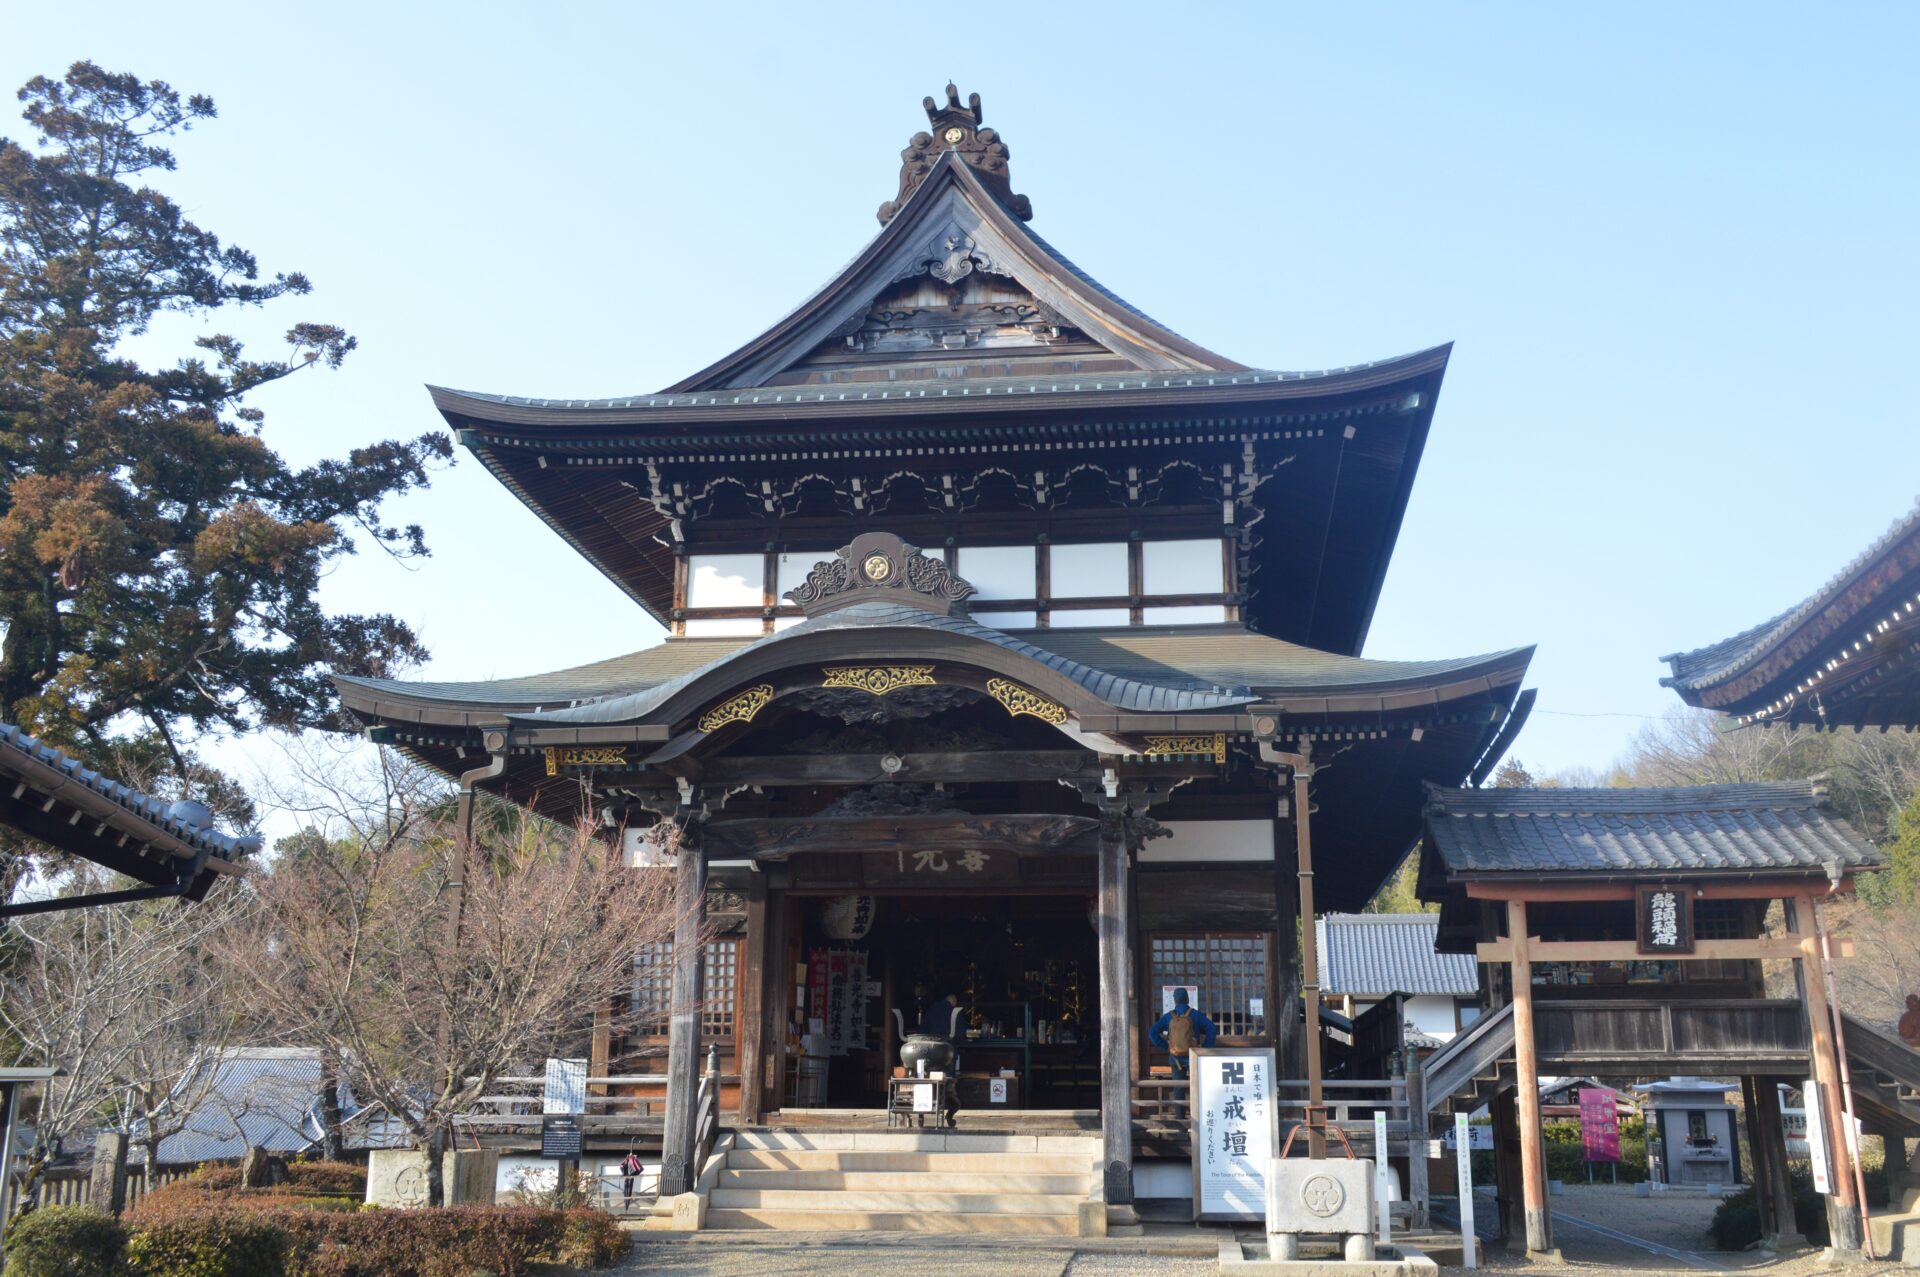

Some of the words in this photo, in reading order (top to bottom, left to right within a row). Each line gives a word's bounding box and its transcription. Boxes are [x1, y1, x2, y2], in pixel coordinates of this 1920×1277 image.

[899, 850, 991, 873] 善光
[1651, 892, 1678, 946] 龍頭稲荷
[1253, 1064, 1263, 1116] 日本で唯一つ
